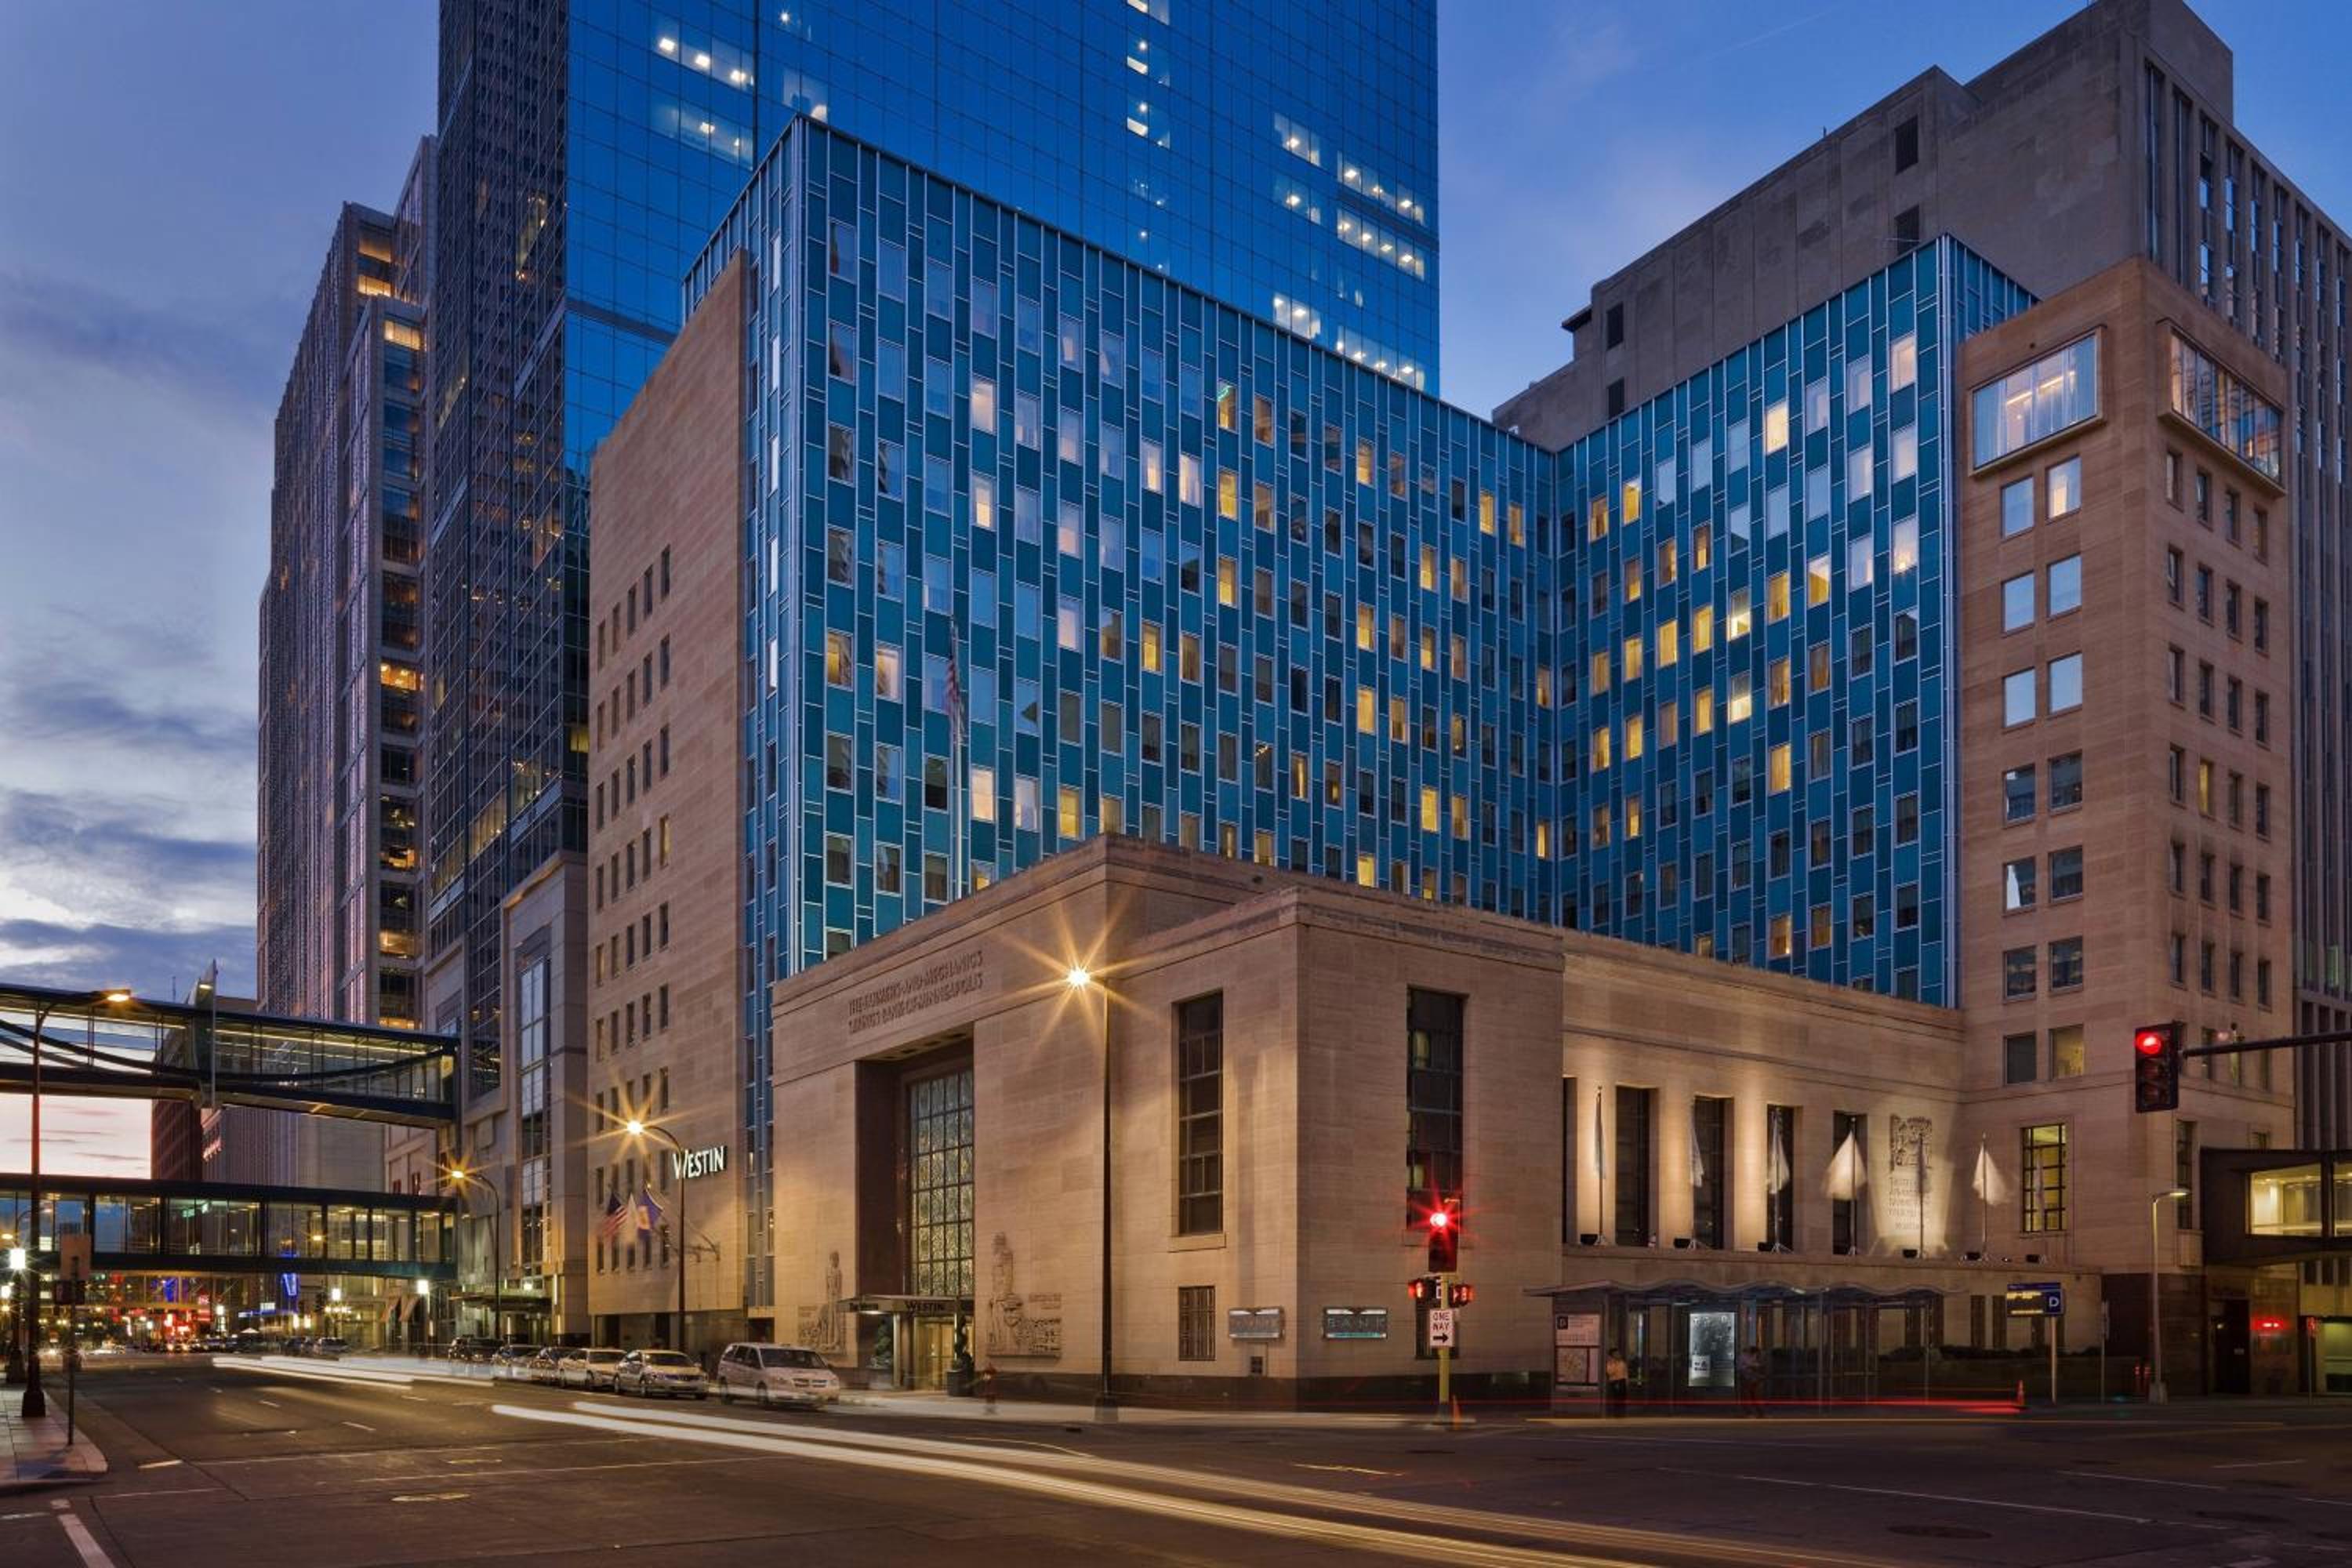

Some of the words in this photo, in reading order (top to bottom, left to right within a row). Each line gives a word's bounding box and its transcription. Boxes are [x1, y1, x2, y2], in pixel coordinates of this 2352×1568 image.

[673, 1145, 724, 1179] WESTIN
[2049, 1297, 2060, 1308] D
[1432, 1312, 1450, 1321] ONE
[1432, 1322, 1450, 1330] WAY
